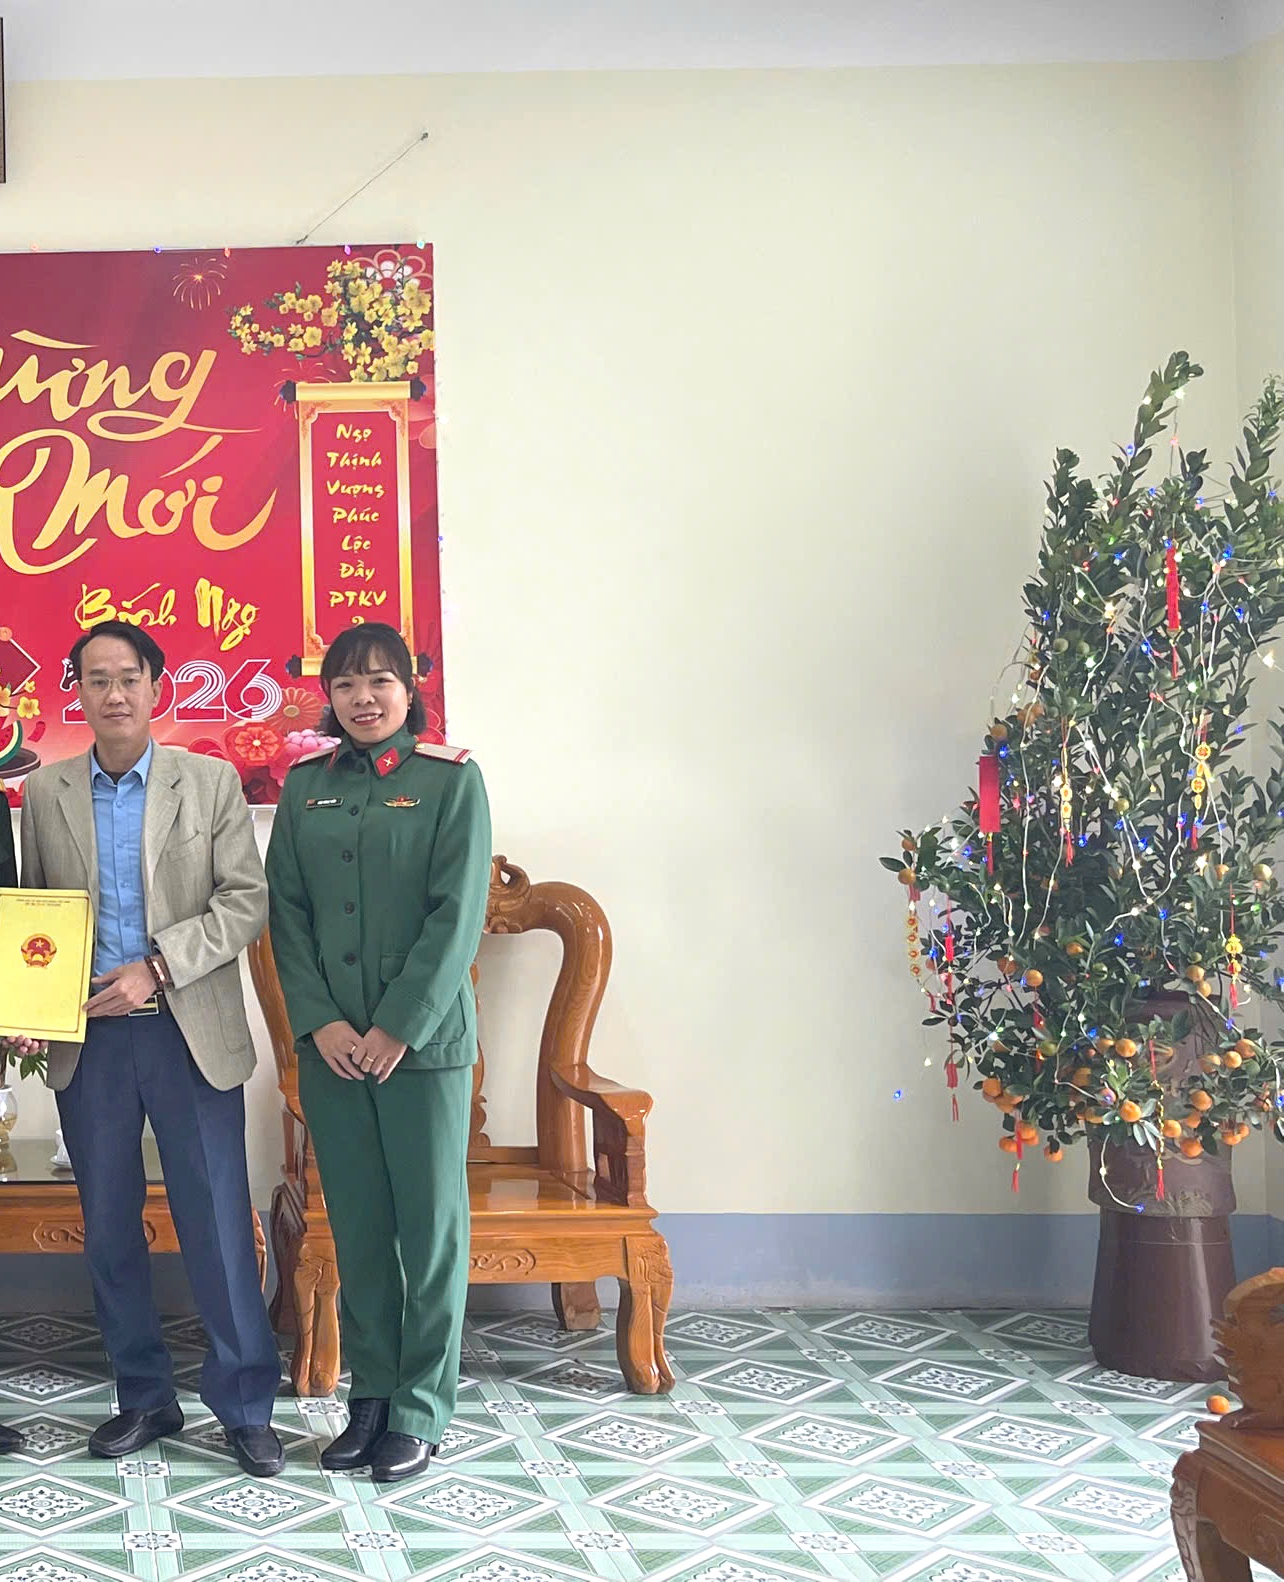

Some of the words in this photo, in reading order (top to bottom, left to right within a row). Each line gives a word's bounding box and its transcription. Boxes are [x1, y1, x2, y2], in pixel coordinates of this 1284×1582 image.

[336, 423, 372, 443] Ngọ
[326, 451, 382, 470] Thịnh
[326, 479, 385, 499] Vượng
[332, 506, 380, 524] Phúc
[341, 534, 371, 554] Lộc
[339, 559, 375, 582] Đầy
[329, 590, 387, 608] PTKV
[74, 582, 177, 631] Bính
[194, 577, 260, 651] Ngọ
